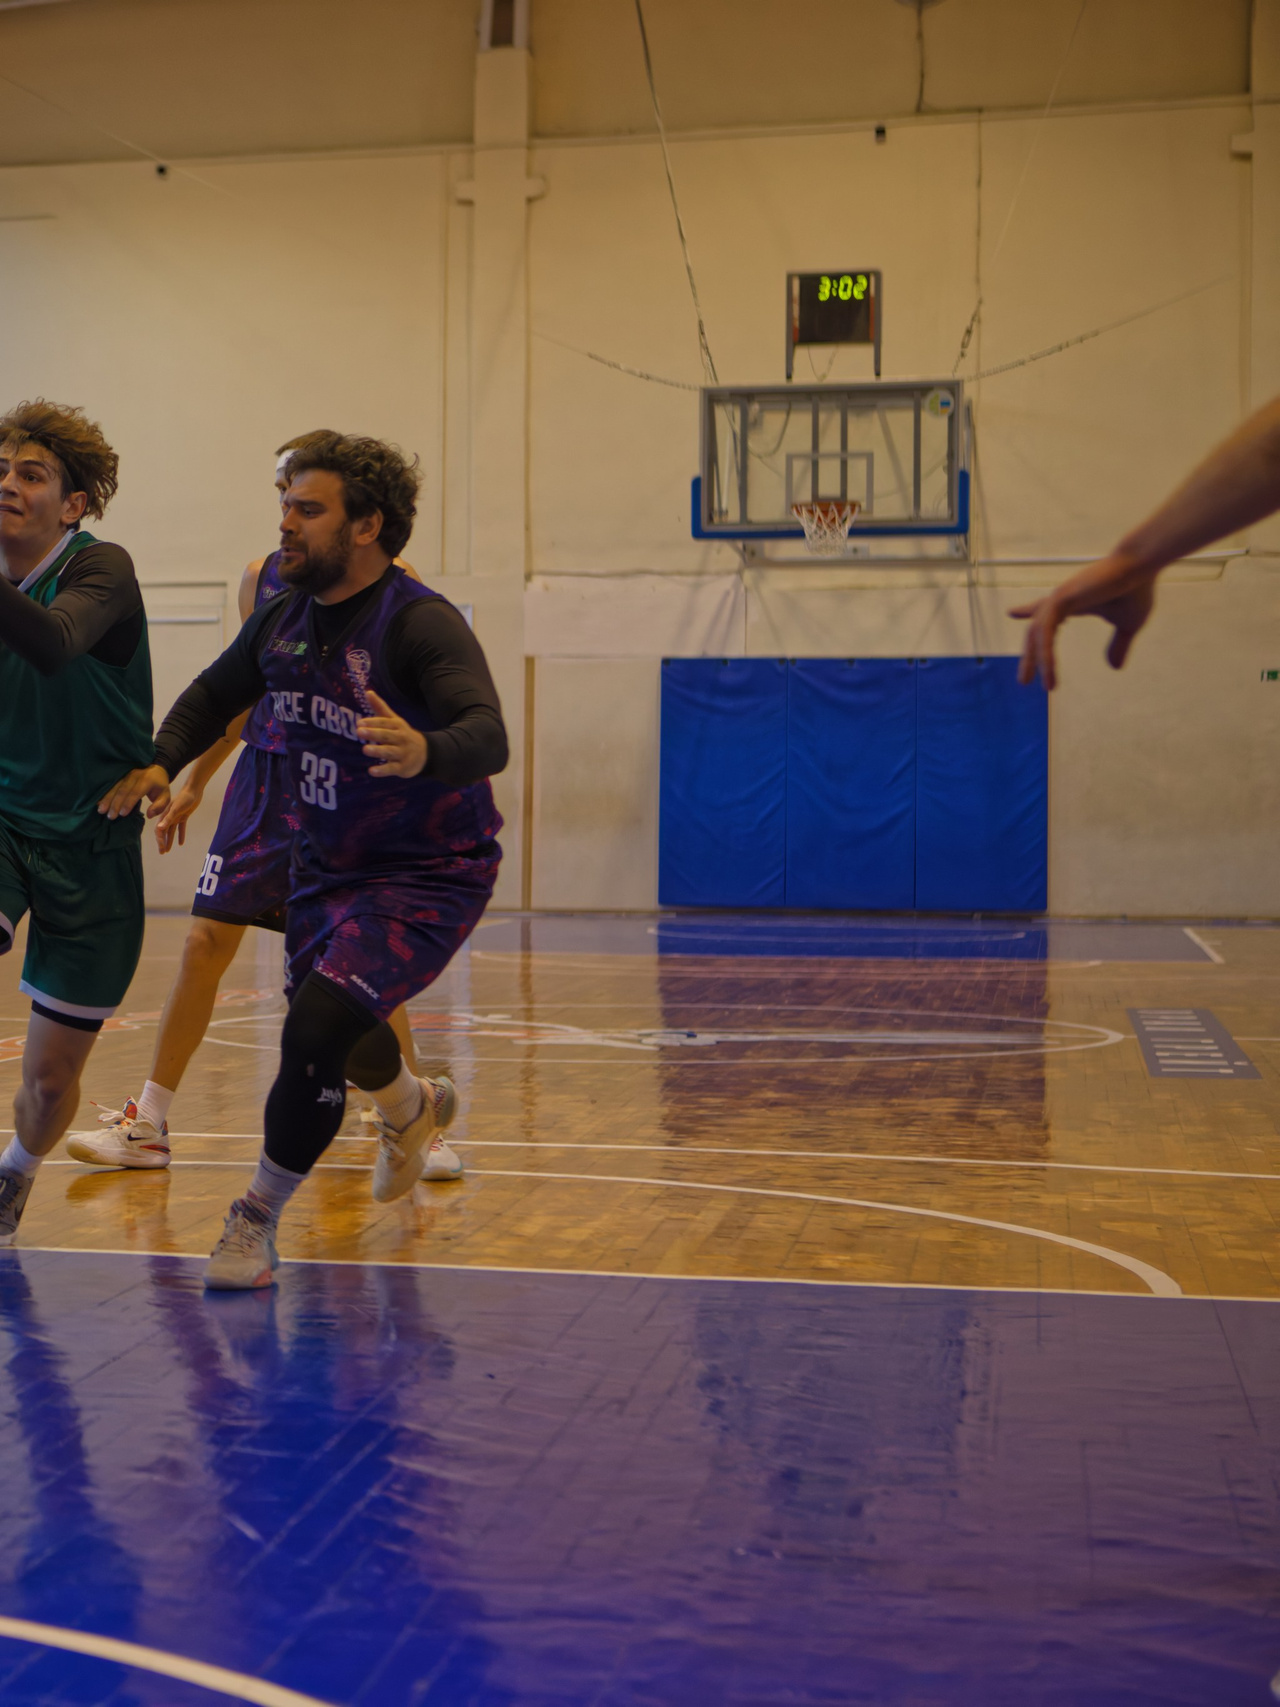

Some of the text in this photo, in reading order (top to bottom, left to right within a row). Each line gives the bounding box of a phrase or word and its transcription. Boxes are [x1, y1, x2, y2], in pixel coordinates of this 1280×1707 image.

[818, 274, 868, 301] 3:02
[271, 691, 308, 725] ВСЕ
[300, 751, 338, 811] 33
